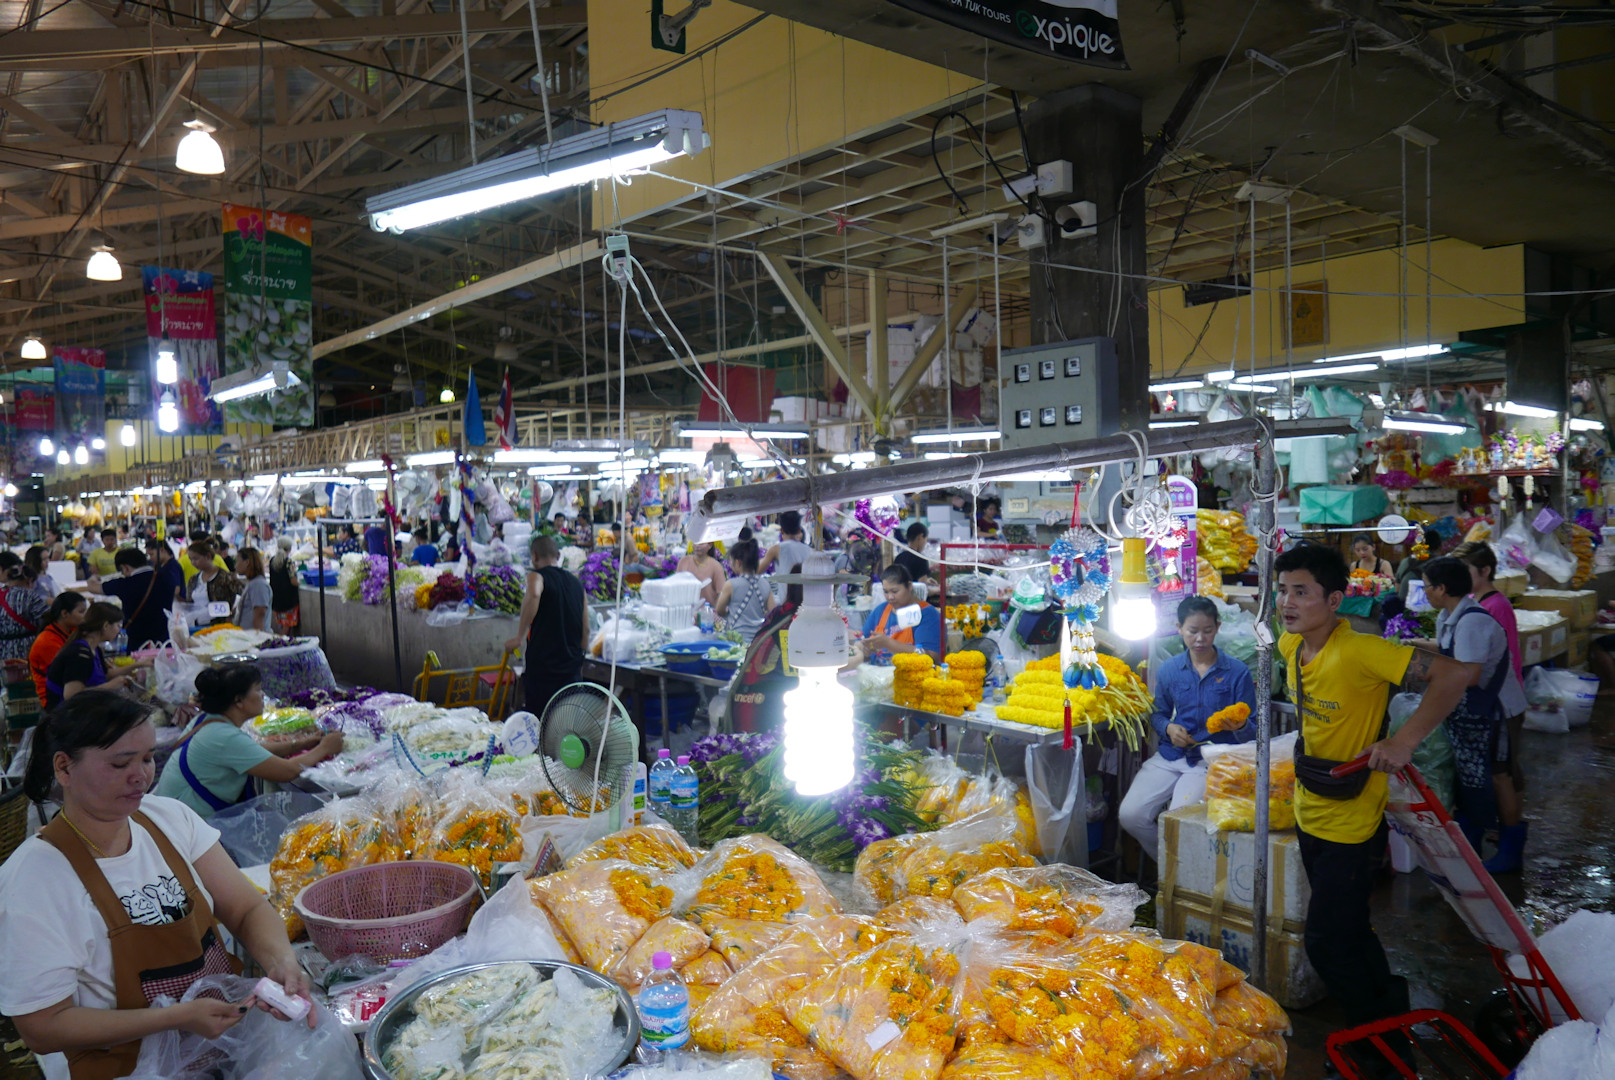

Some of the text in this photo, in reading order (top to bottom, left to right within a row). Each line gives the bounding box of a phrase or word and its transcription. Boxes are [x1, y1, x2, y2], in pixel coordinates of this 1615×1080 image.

[965, 0, 981, 15] TUK
[981, 5, 1012, 24] TOURS
[1015, 9, 1116, 59] expique
[734, 692, 754, 704] unicef
